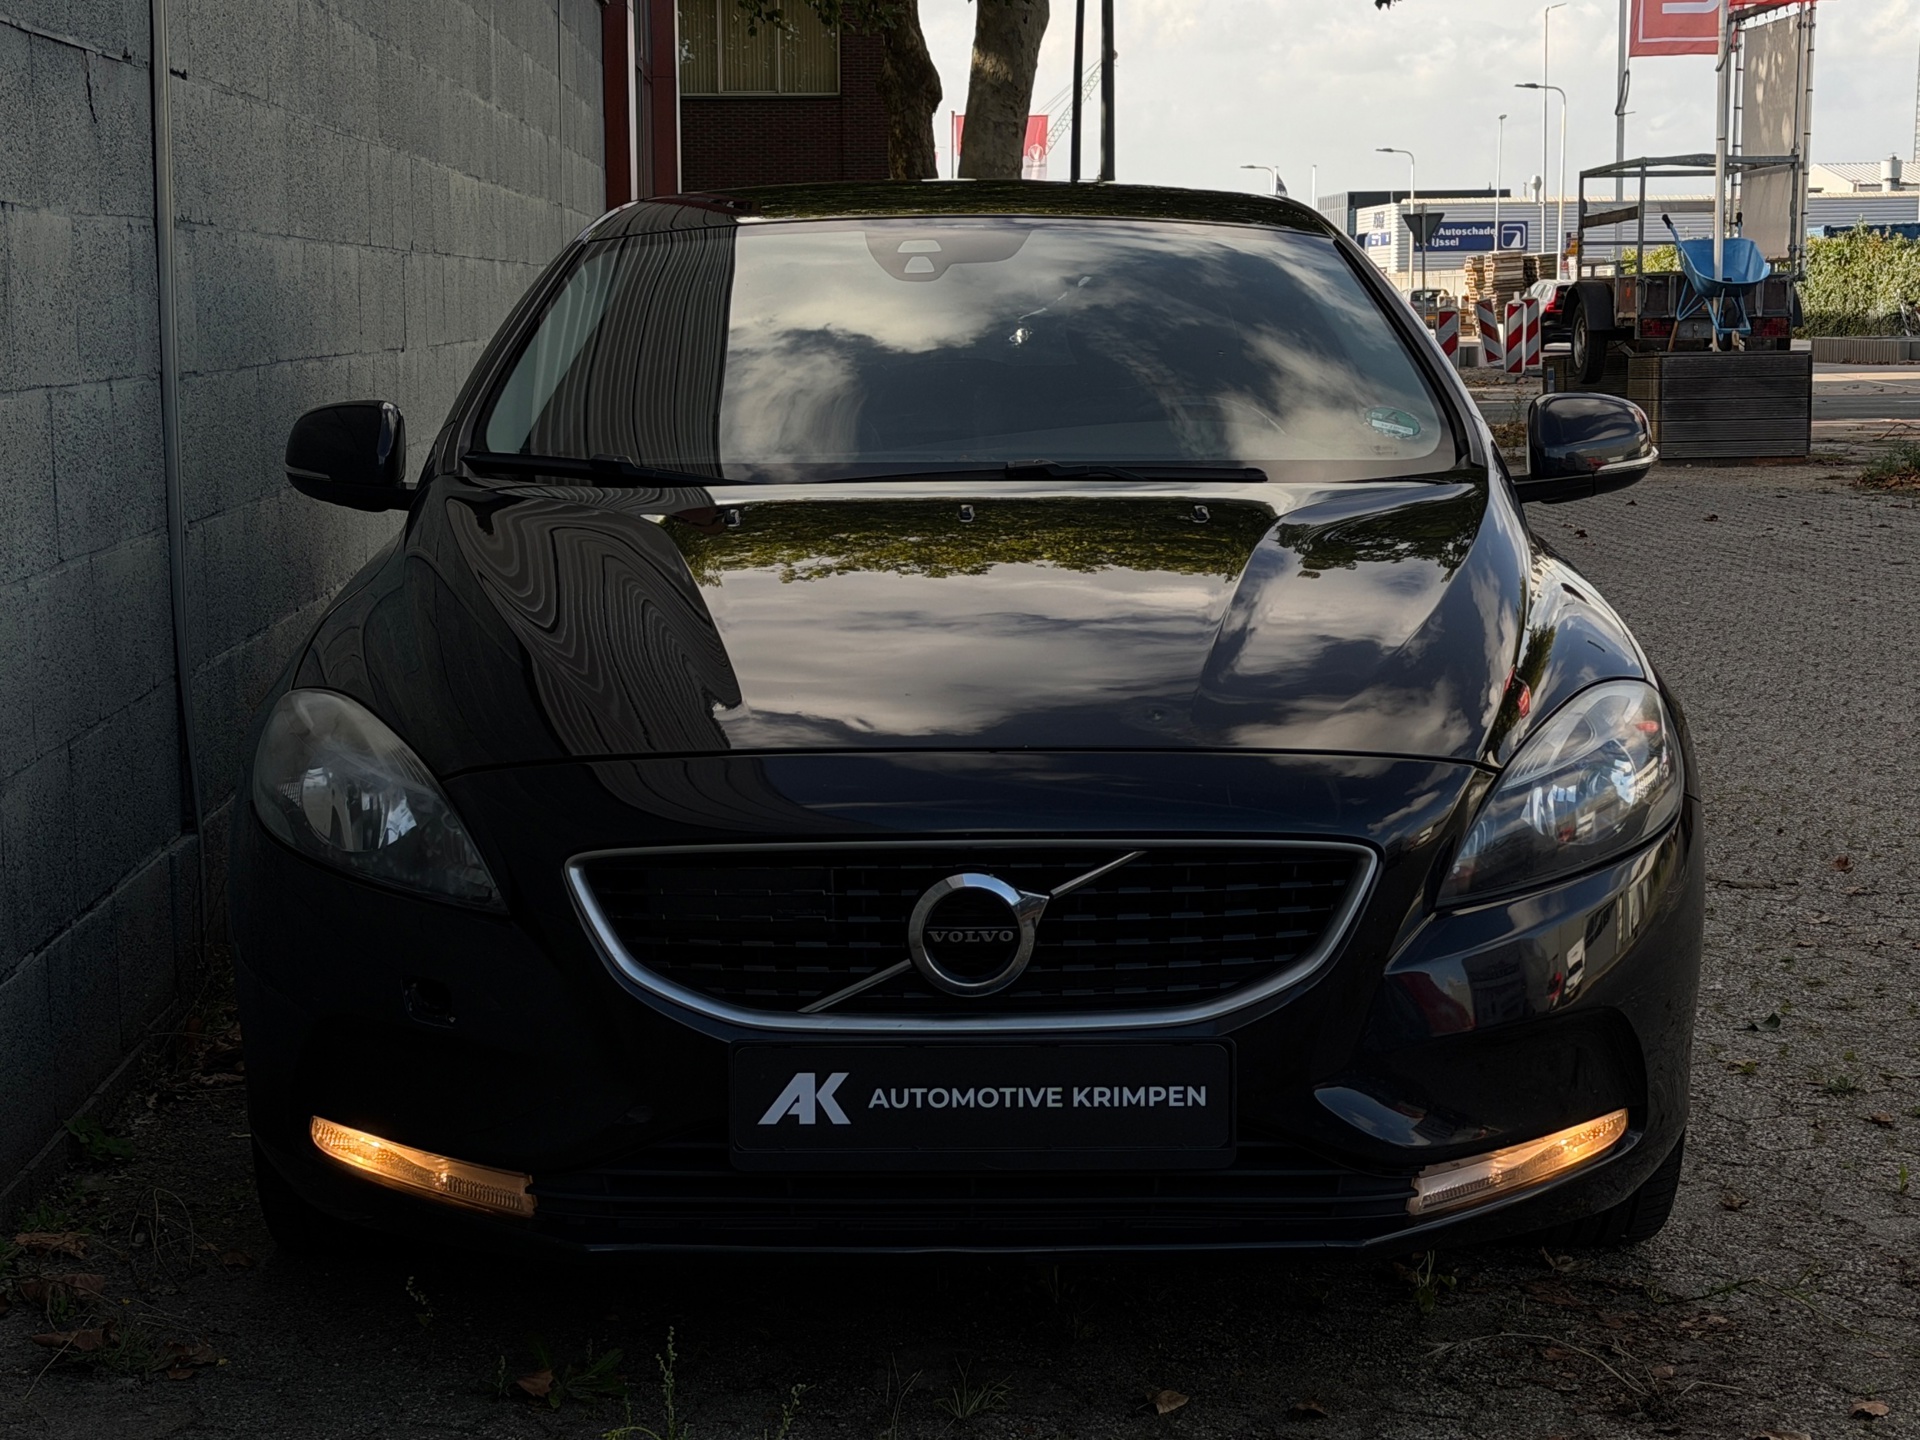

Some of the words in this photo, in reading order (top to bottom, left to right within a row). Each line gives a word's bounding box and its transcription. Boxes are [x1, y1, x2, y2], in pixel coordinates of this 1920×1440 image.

[1438, 226, 1496, 236] Autoschade
[927, 930, 1014, 943] VOLVO
[758, 1073, 851, 1124] AK
[868, 1087, 1063, 1109] AUTOMOTIVE
[1072, 1085, 1207, 1108] KRIMPEN
